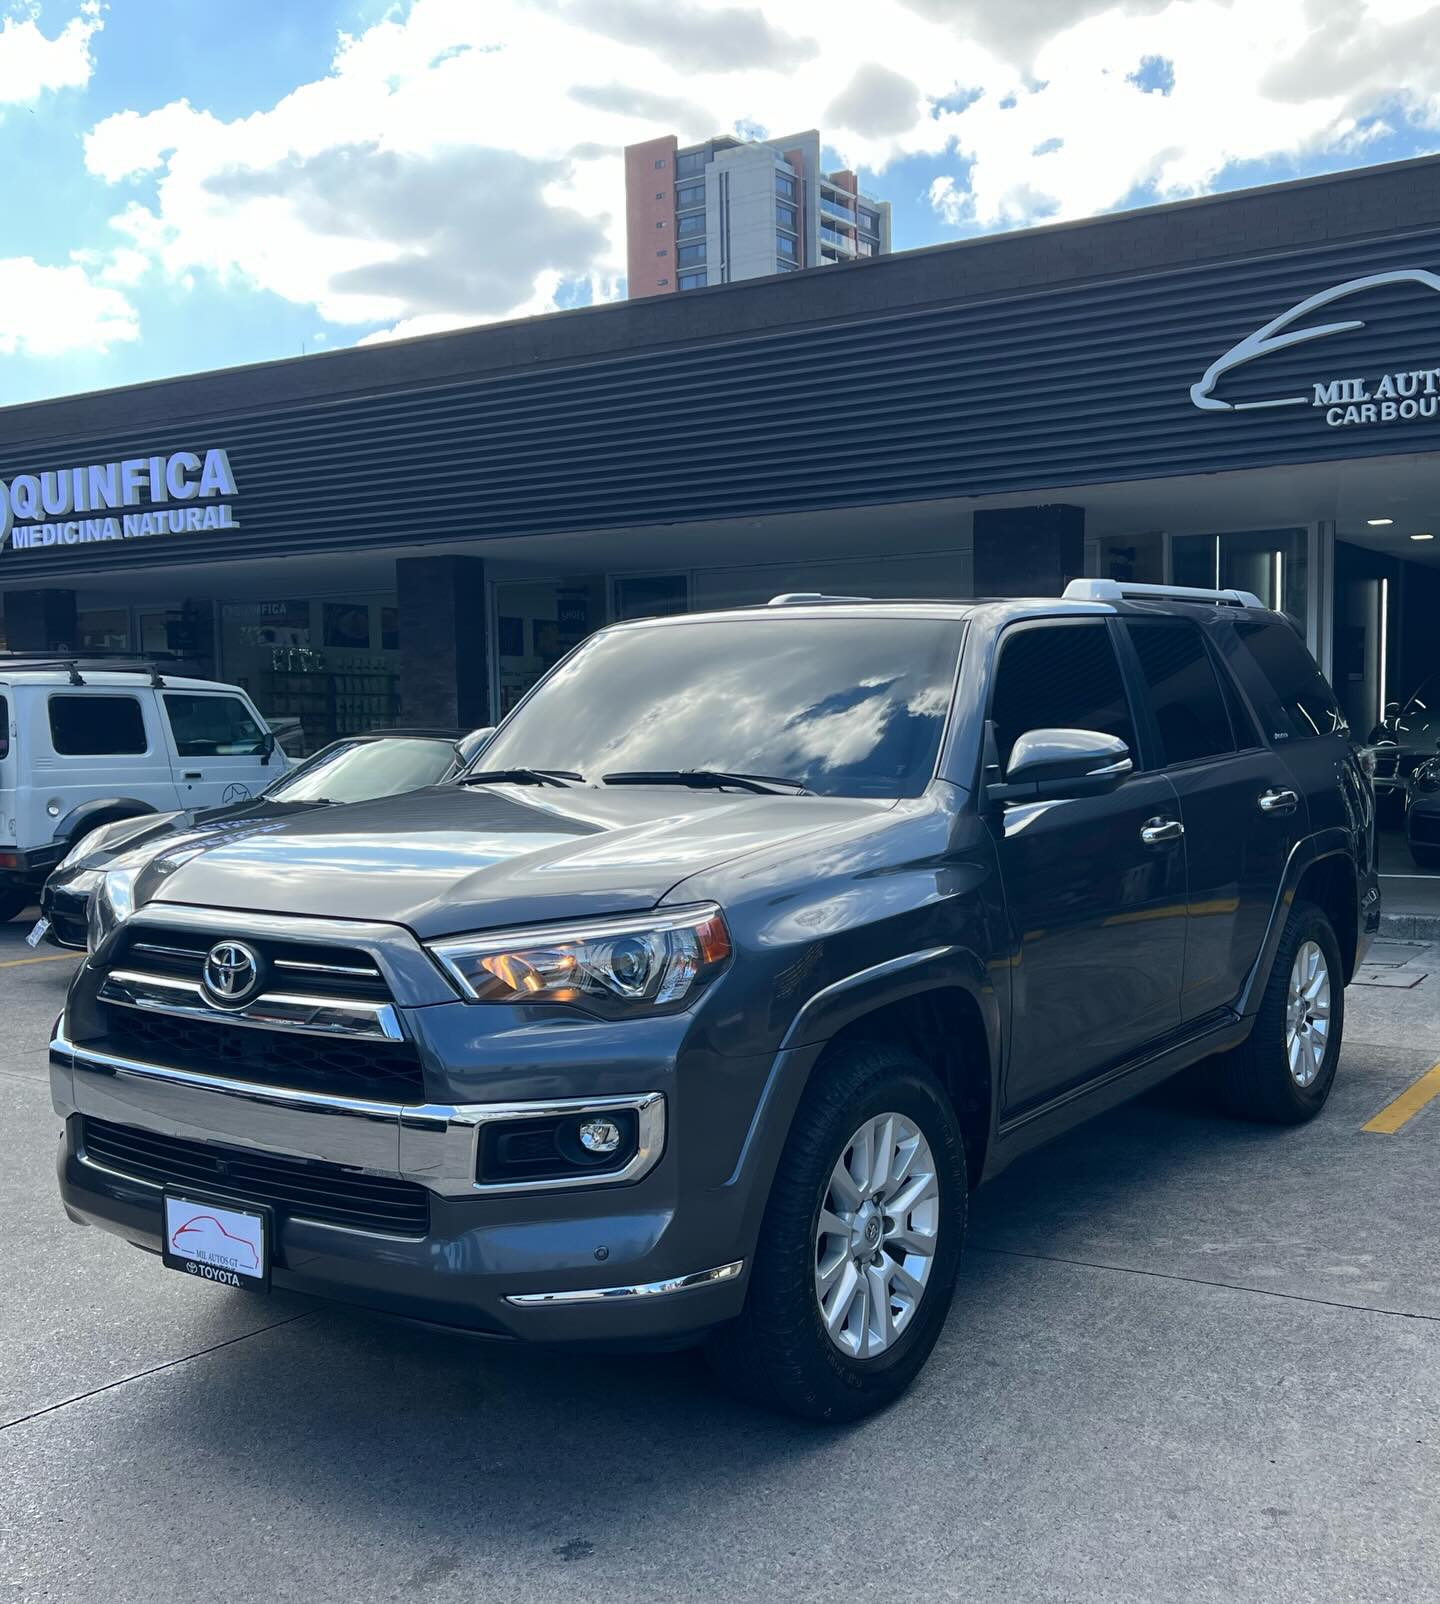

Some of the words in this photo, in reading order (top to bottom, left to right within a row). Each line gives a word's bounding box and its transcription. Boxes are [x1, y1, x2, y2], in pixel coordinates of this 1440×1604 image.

[1313, 378, 1371, 407] MIL
[1374, 367, 1440, 399] AUT
[1326, 402, 1378, 426] CAR
[1381, 396, 1440, 422] BOU
[10, 448, 239, 521] QUINFICA
[12, 517, 123, 549] MEDICINA
[123, 504, 240, 538] NATURAL
[196, 1249, 208, 1260] MIL
[208, 1252, 229, 1265] AUTOS
[229, 1258, 239, 1268] GT
[198, 1264, 240, 1287] TOYOTA
